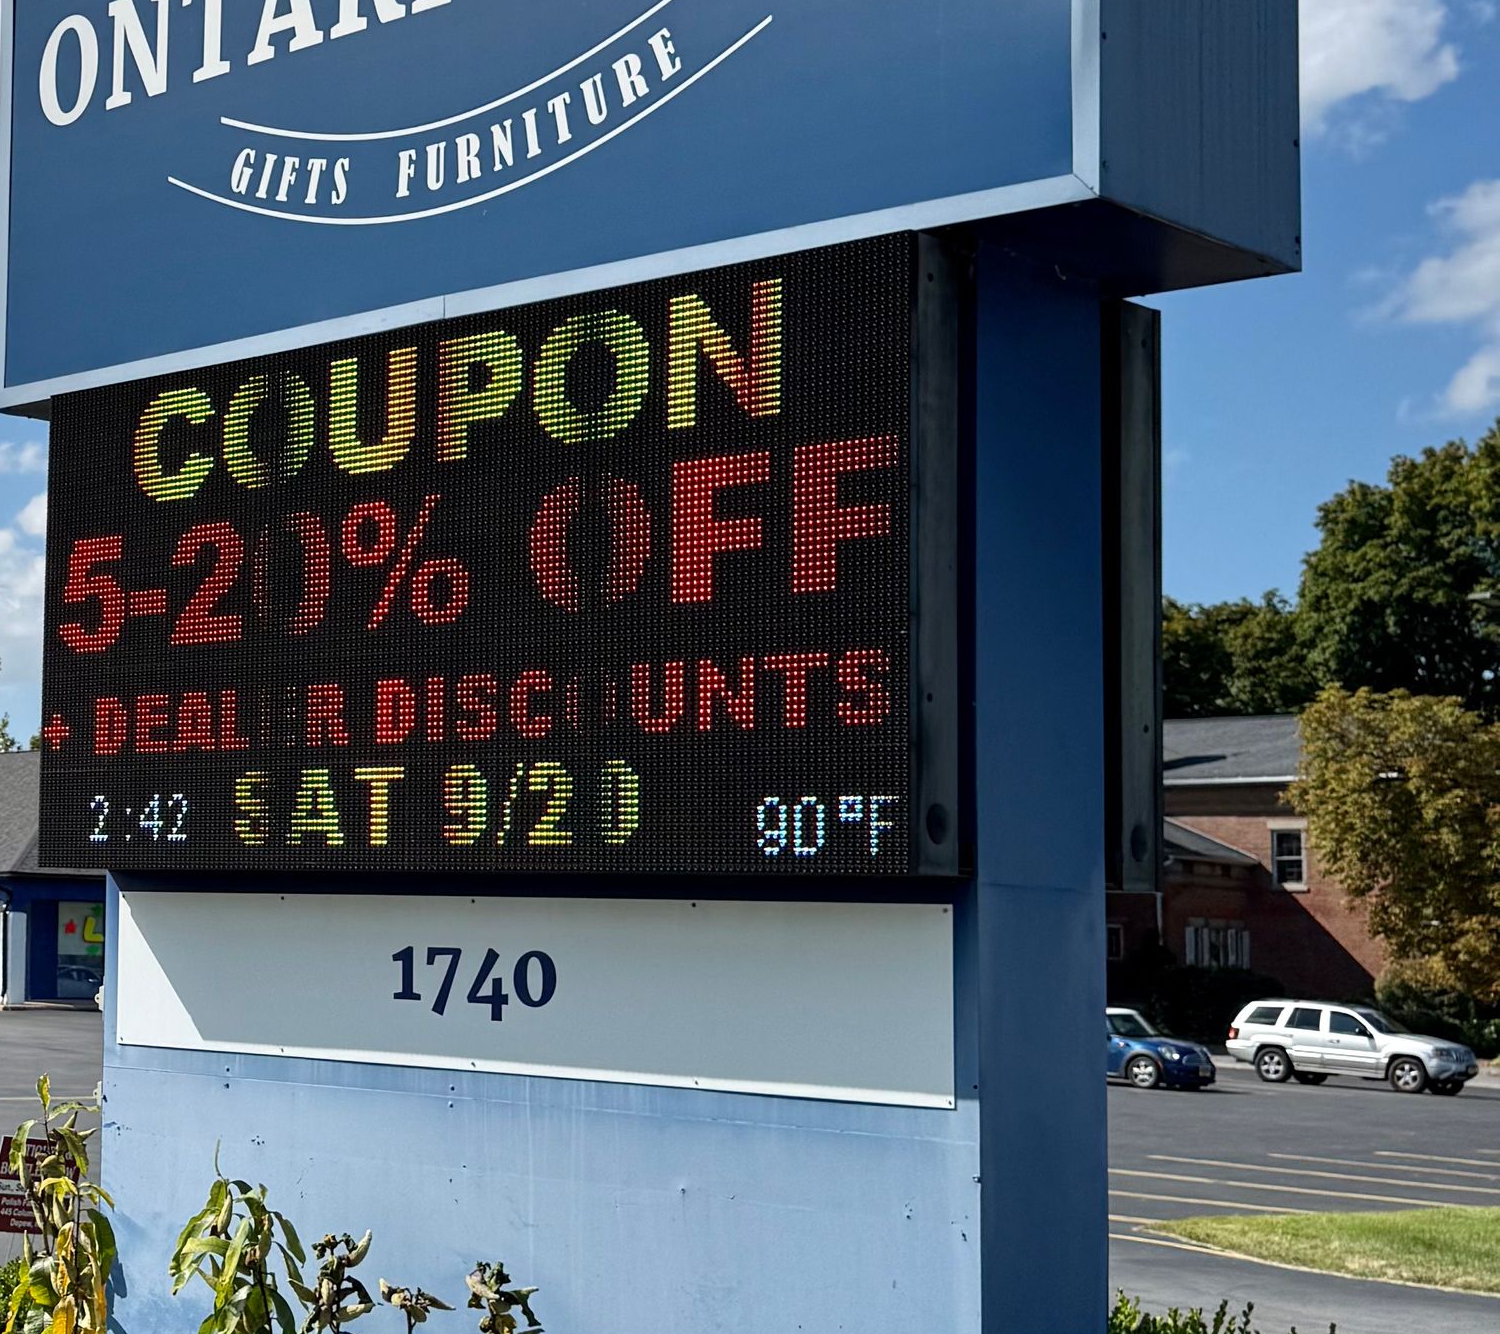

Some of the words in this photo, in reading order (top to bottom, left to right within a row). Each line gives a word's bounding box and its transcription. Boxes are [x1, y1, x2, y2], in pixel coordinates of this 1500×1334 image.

[230, 147, 351, 205] GIFTS
[394, 26, 683, 199] FURNITURE
[133, 278, 784, 502] COUPON
[57, 493, 472, 655] 5-20%
[530, 433, 900, 614] OFF
[234, 765, 406, 847] SAT
[442, 759, 640, 848] 9/20
[391, 944, 558, 1022] 1740
